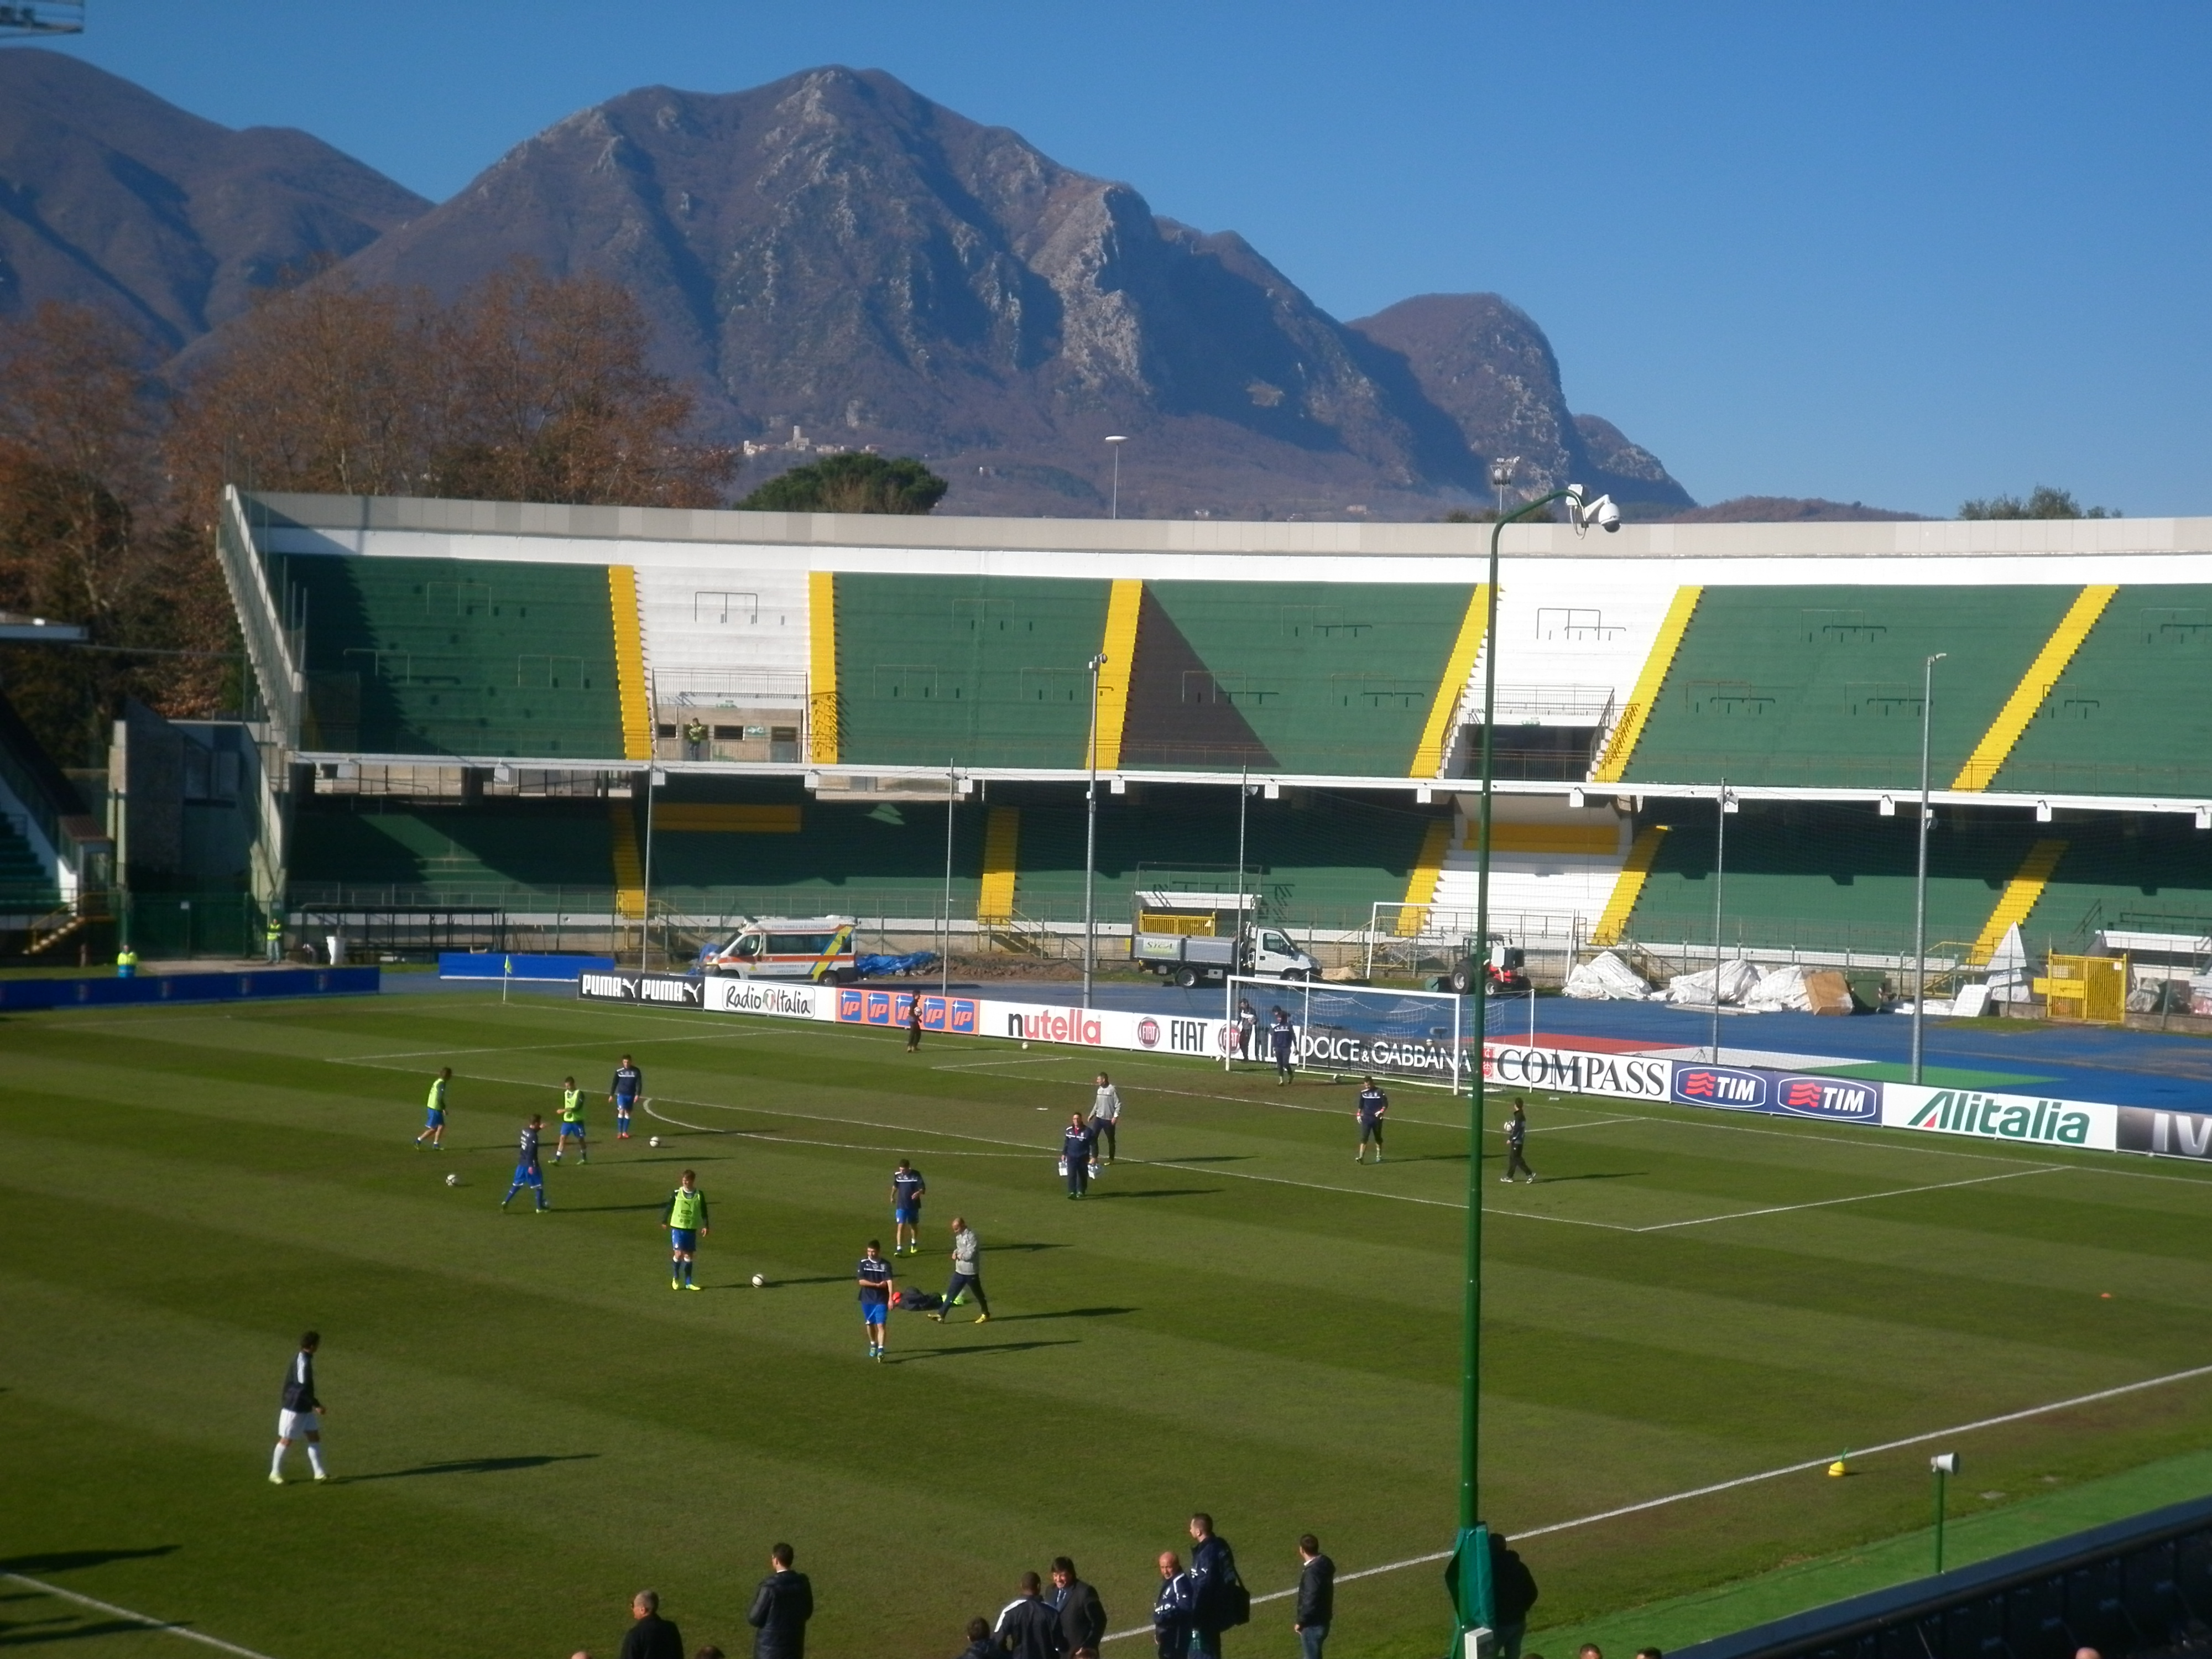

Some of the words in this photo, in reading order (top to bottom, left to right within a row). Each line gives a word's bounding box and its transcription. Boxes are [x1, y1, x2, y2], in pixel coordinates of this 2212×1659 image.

[582, 975, 622, 997] PUMA
[641, 979, 684, 1001] PUMA
[726, 985, 761, 1009] Radio
[776, 989, 811, 1014] Italia
[843, 1001, 859, 1015] IP
[870, 1004, 887, 1018] IP
[926, 1009, 944, 1023] IP
[953, 1011, 972, 1026] IP
[1008, 1009, 1102, 1045] nutella
[1142, 1026, 1156, 1040] FIAT
[1171, 1020, 1208, 1052] FIAT
[1223, 1032, 1238, 1047] FAT
[1301, 1036, 1360, 1061] DOLCE
[1361, 1050, 1370, 1062] &
[1371, 1041, 1472, 1072] GABBANA
[1497, 1049, 1664, 1096] COMPASS
[1717, 1076, 1756, 1101] TIM
[1823, 1087, 1865, 1113] TIM
[1907, 1091, 2090, 1144] Alitalia
[2153, 1113, 2212, 1155] IV
